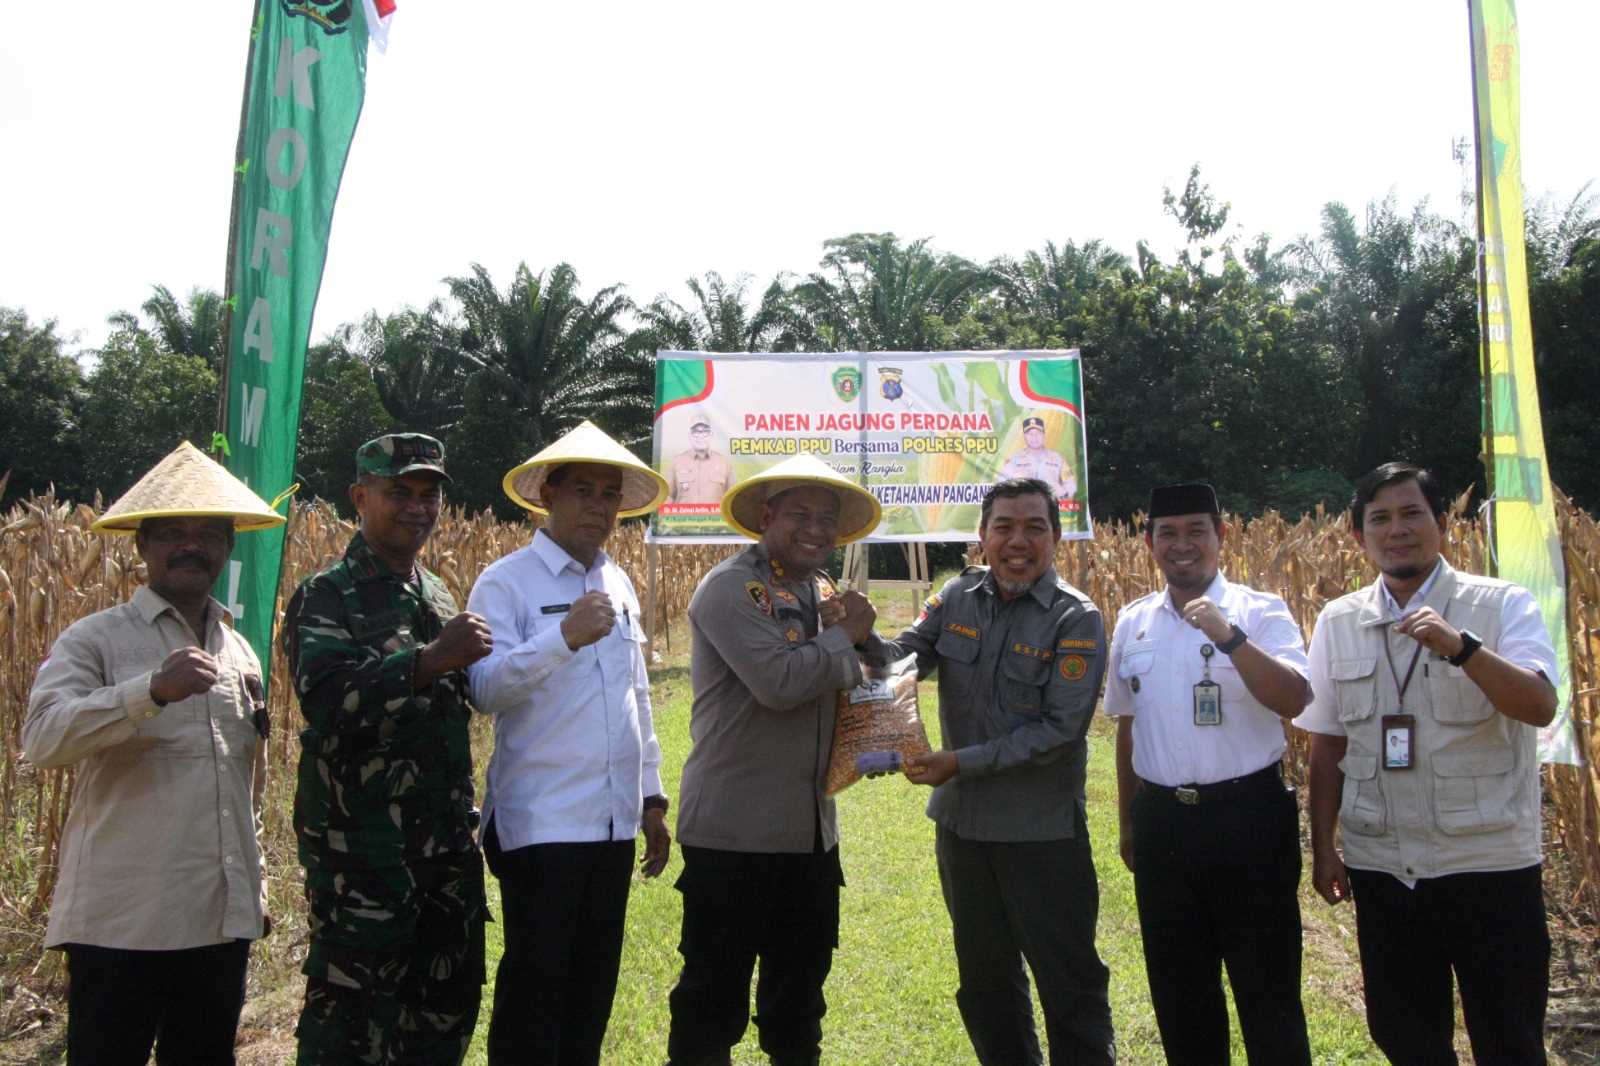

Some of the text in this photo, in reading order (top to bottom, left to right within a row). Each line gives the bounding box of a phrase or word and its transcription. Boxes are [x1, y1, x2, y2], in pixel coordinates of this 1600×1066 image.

[227, 37, 322, 619] KORAML
[744, 413, 991, 431] PANEN JAGUNG PERDANA
[730, 437, 998, 454] PEMKAB PPU Bersama POLRES PPU
[877, 486, 940, 504] KETAHANAN
[943, 485, 987, 503] PANGAN
